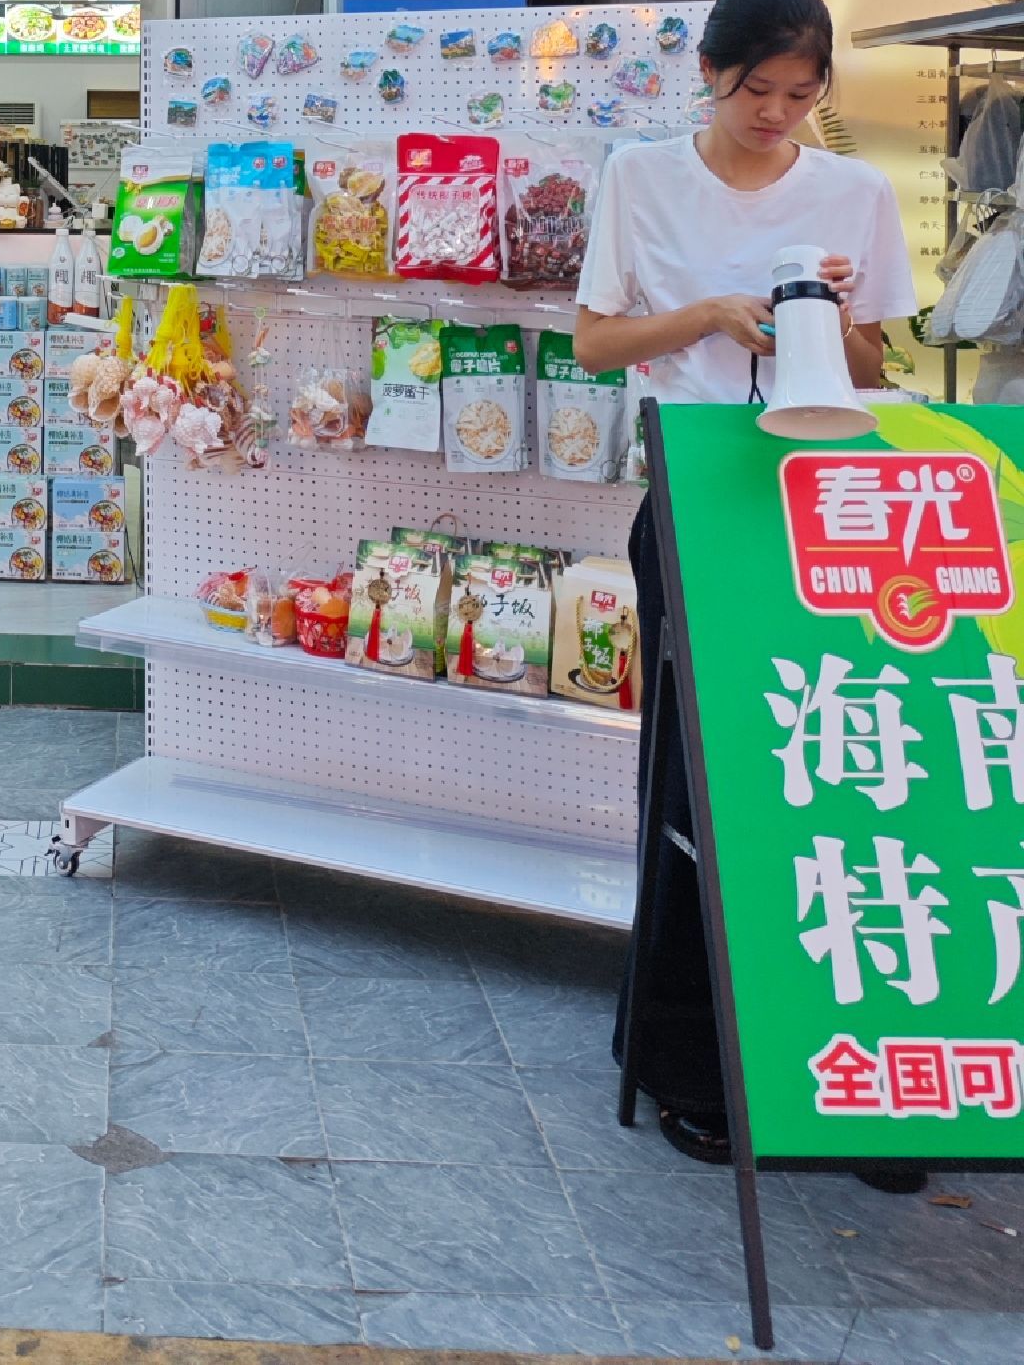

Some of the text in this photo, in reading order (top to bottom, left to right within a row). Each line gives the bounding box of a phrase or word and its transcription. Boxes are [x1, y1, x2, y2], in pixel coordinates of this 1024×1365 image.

[814, 464, 970, 567] 春光
[810, 566, 1002, 595] CHUN GUANG
[808, 1033, 1024, 1119] 全国可
